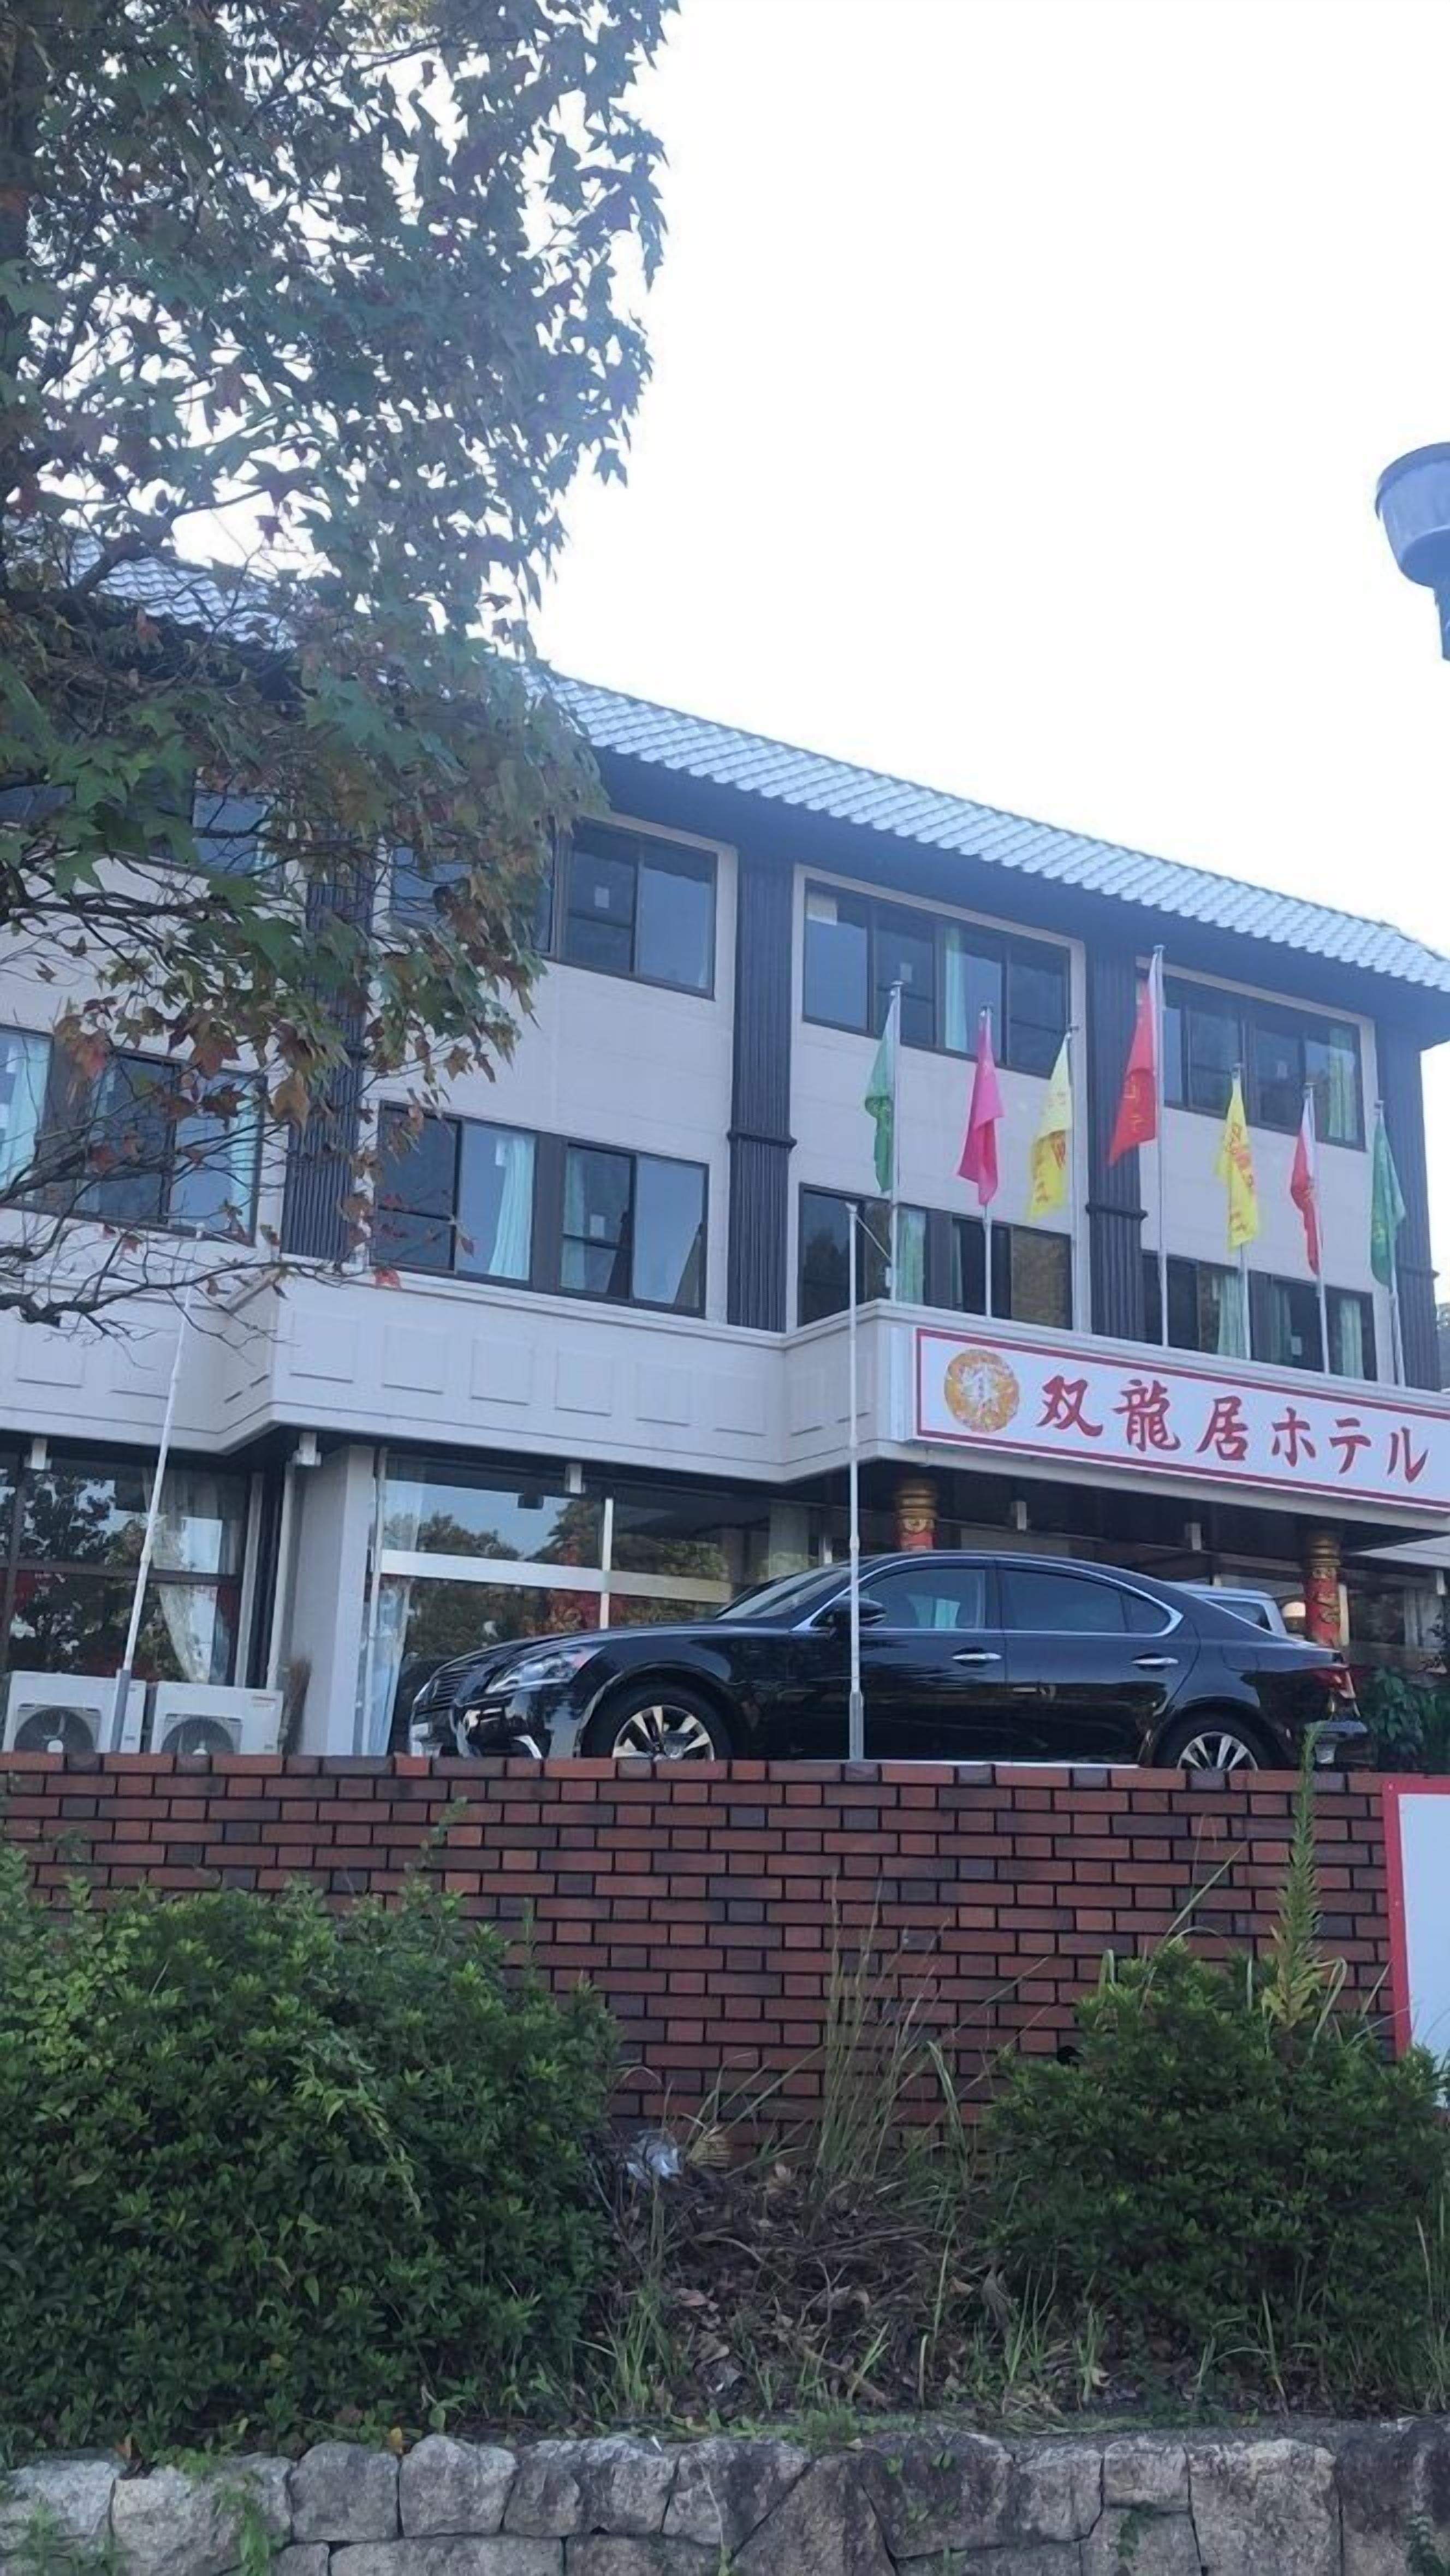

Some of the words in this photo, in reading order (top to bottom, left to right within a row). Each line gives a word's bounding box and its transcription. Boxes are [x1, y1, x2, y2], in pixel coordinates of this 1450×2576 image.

[1036, 1375, 1429, 1483] 双龍居ホテル
